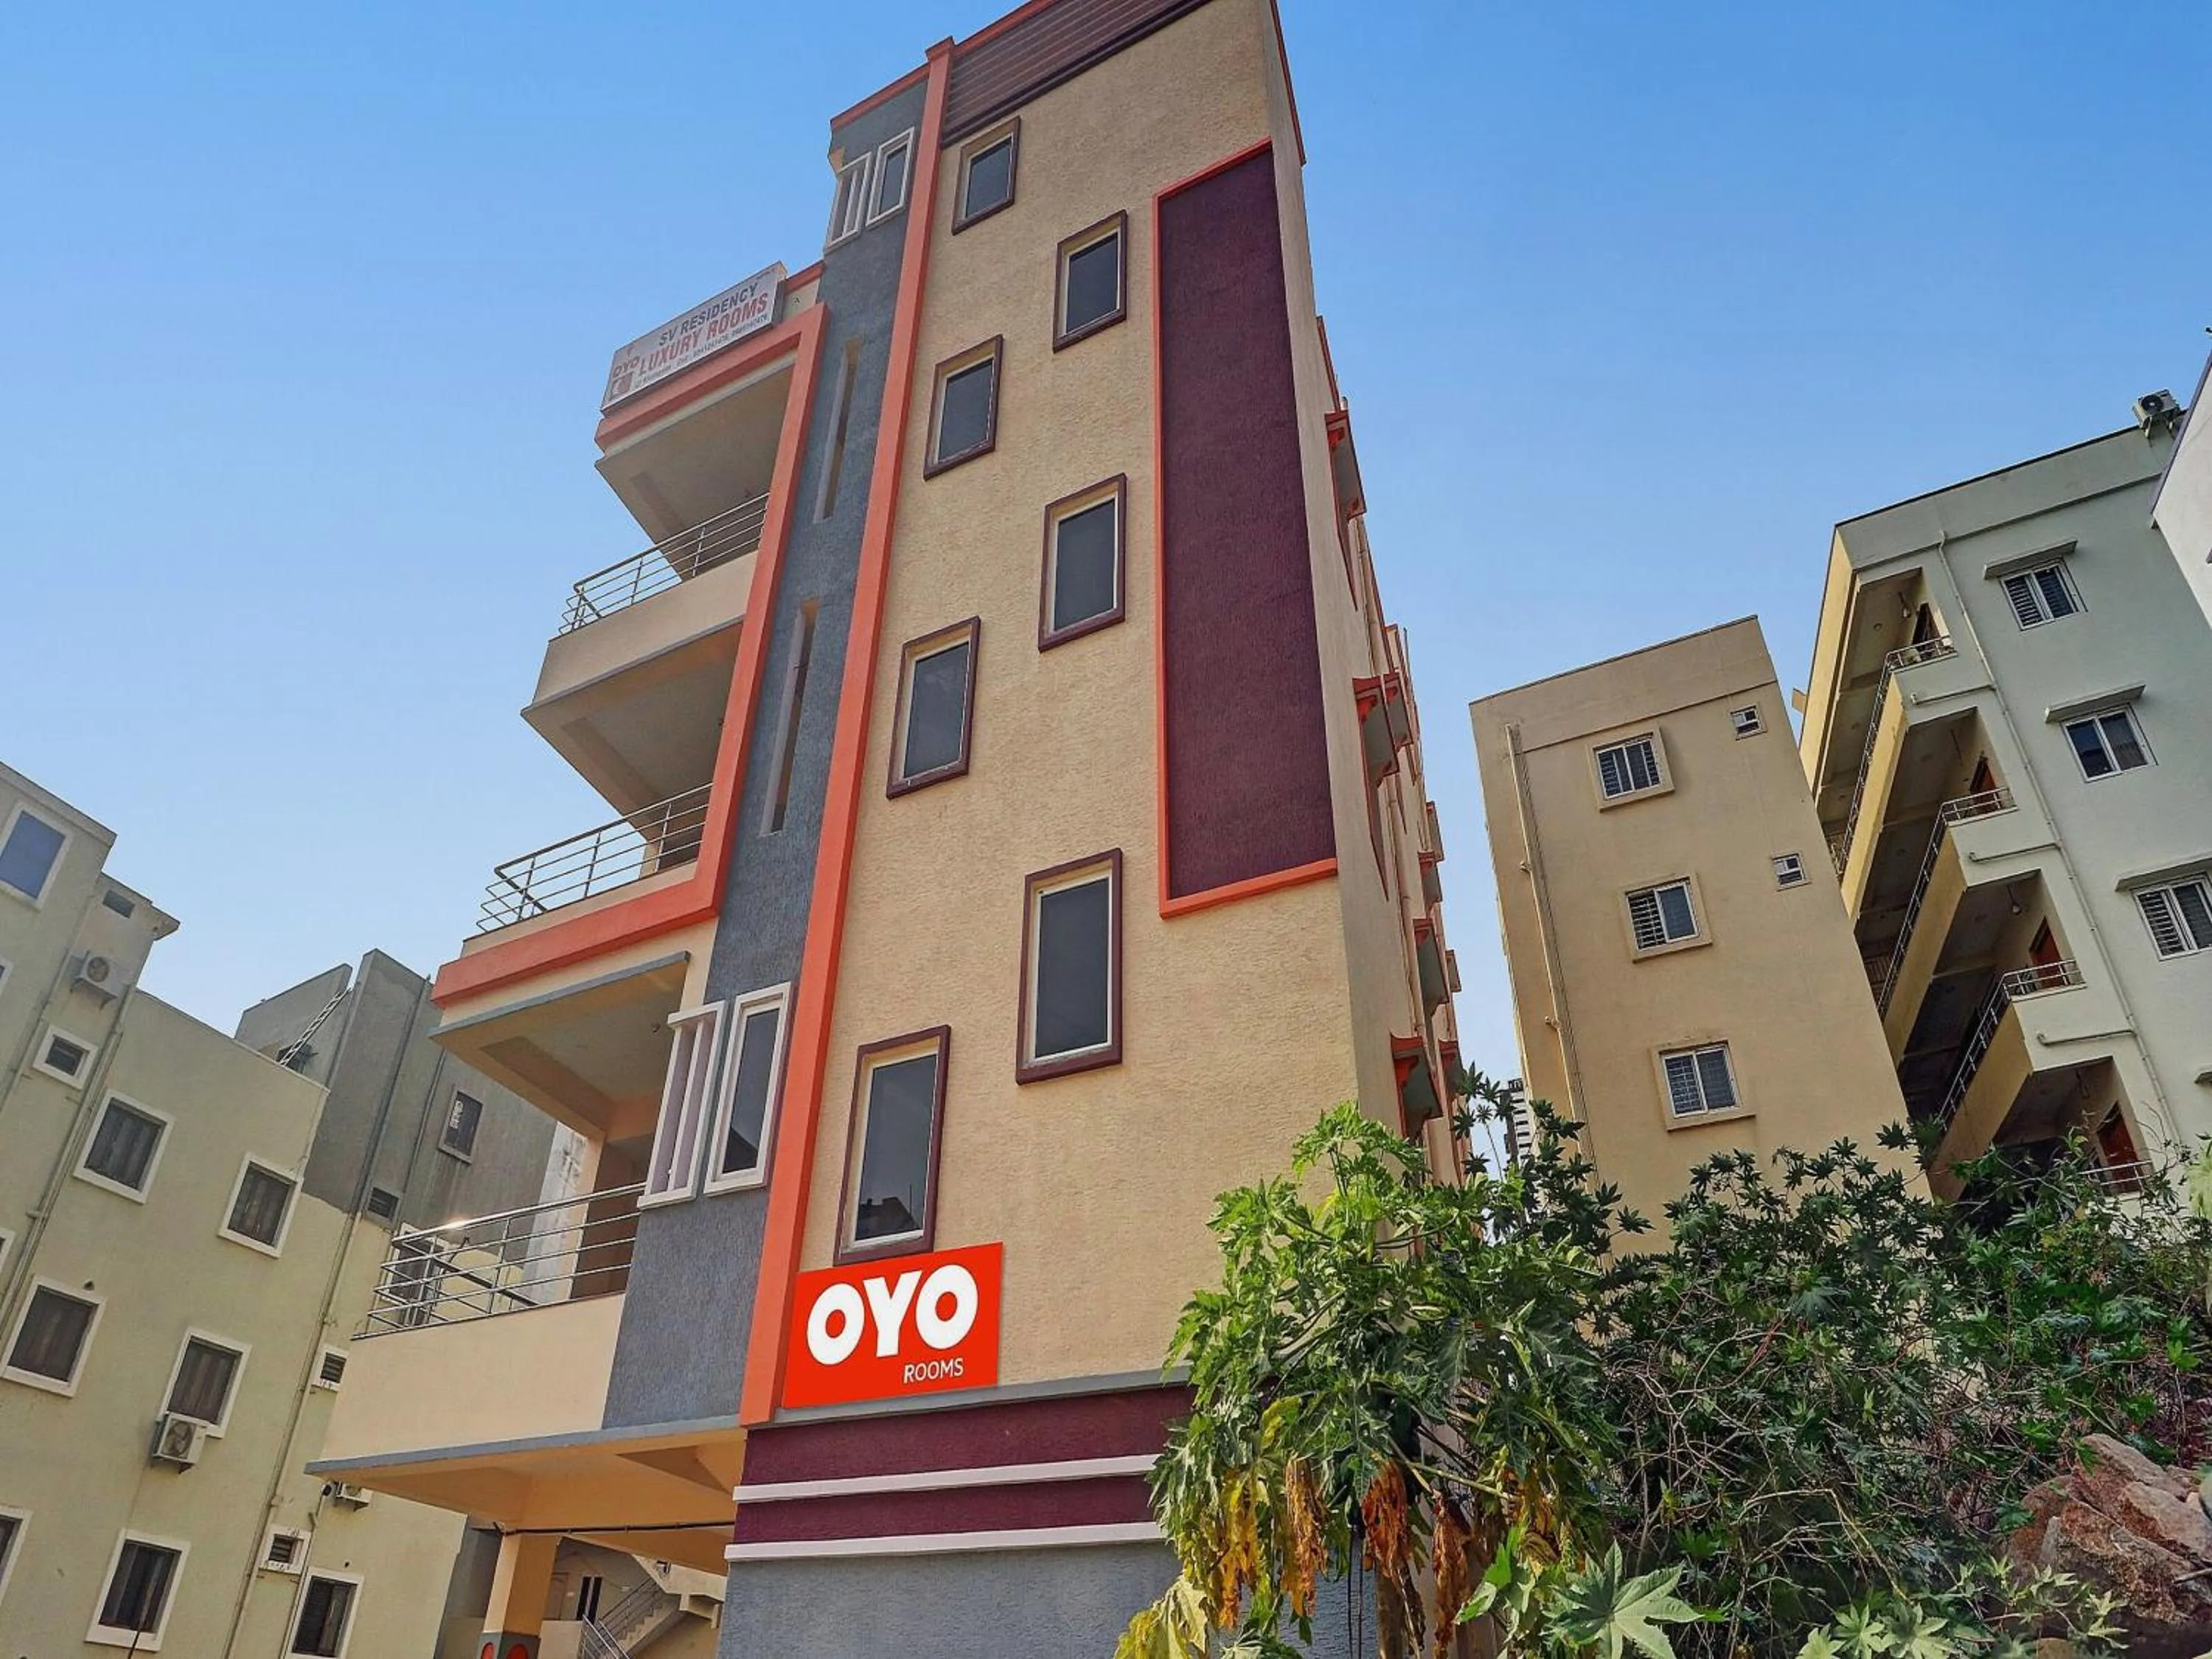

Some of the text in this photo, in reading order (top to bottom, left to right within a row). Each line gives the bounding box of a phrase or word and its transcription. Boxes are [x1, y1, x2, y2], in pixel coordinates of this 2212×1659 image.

[639, 327, 703, 376] LUXURY
[706, 292, 768, 340] ROOMS
[659, 325, 677, 346] SV
[680, 282, 758, 335] RESIDENCY
[807, 1264, 978, 1366] OYO
[902, 1357, 964, 1384] ROOMS
